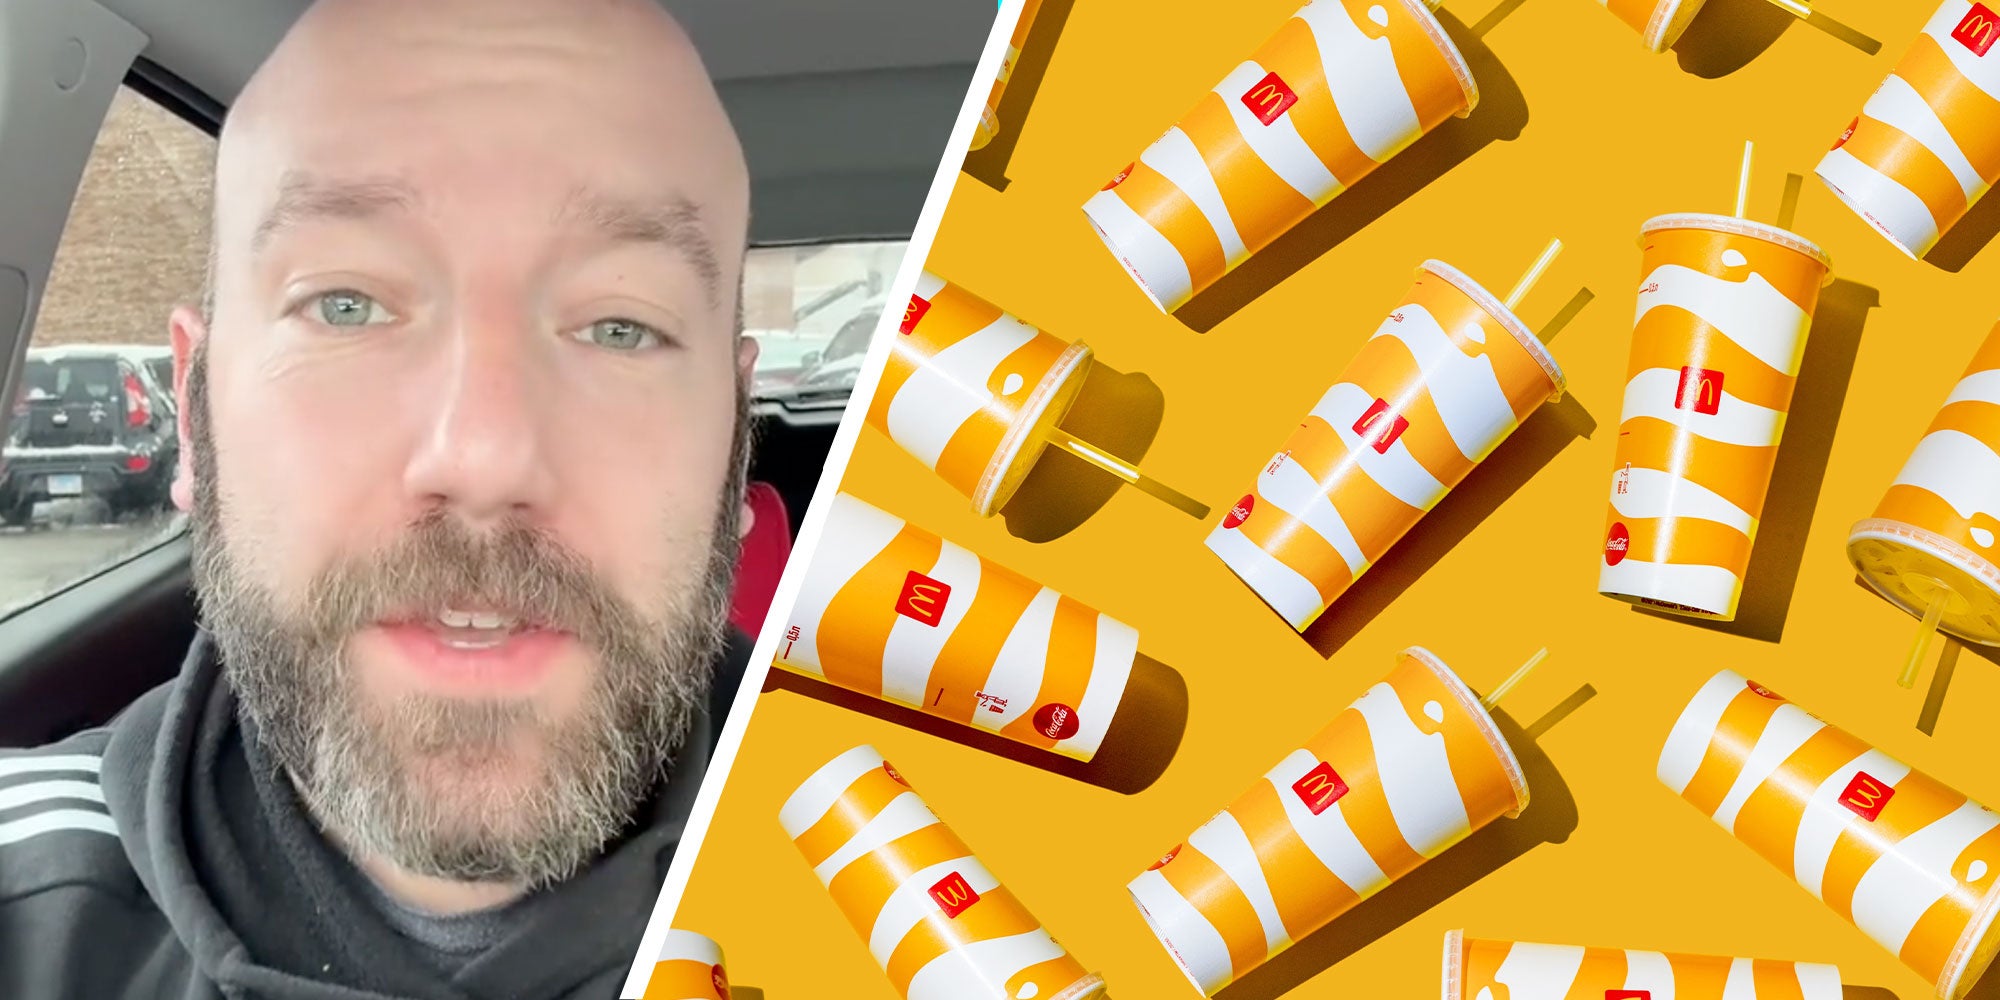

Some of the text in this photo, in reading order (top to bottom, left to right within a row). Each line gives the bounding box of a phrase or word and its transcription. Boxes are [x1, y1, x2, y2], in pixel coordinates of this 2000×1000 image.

[1960, 14, 1993, 47] M
[1251, 84, 1284, 117] M
[908, 584, 941, 618] M
[1302, 773, 1335, 806] M
[1848, 778, 1882, 809] M
[937, 878, 967, 908] M
